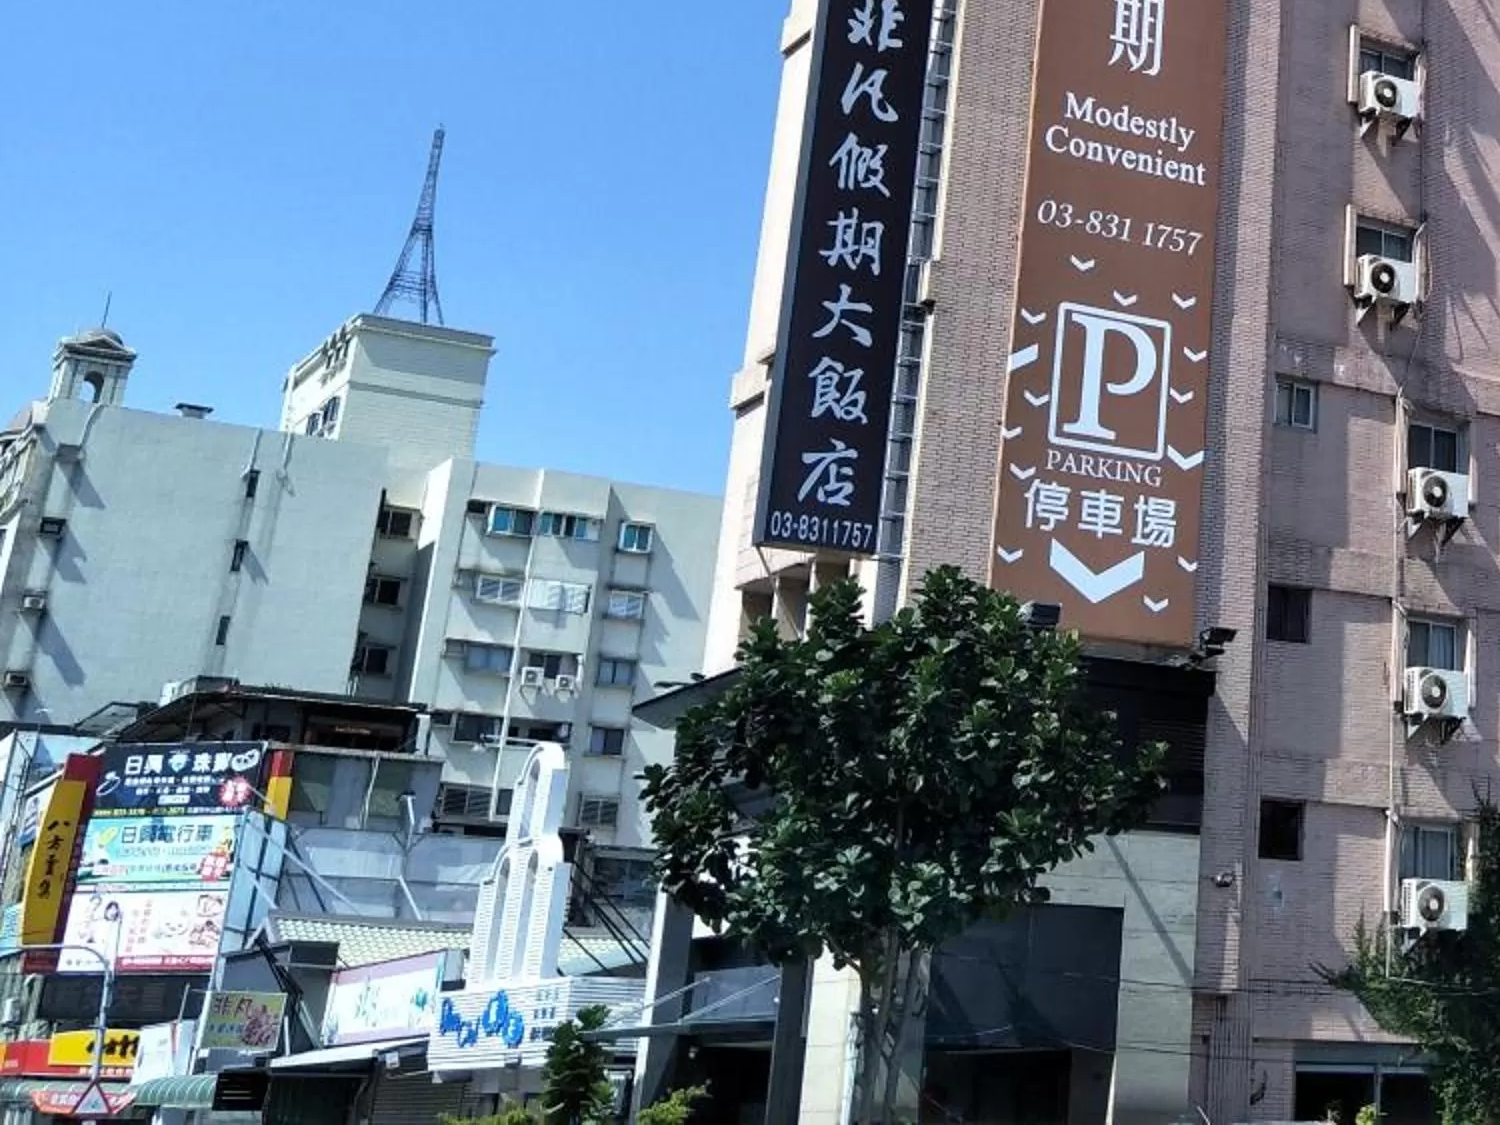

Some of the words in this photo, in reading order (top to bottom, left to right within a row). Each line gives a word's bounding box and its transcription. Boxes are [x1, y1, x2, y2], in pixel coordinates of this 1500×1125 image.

[1063, 90, 1196, 153] Modestly
[1044, 124, 1207, 187] Convenient
[1037, 199, 1132, 242] 03-831
[1141, 222, 1204, 257] 1757
[1062, 311, 1158, 441] P
[1045, 448, 1164, 488] PARKING
[770, 510, 874, 550] 03-8311757
[1023, 477, 1178, 549] 停車場
